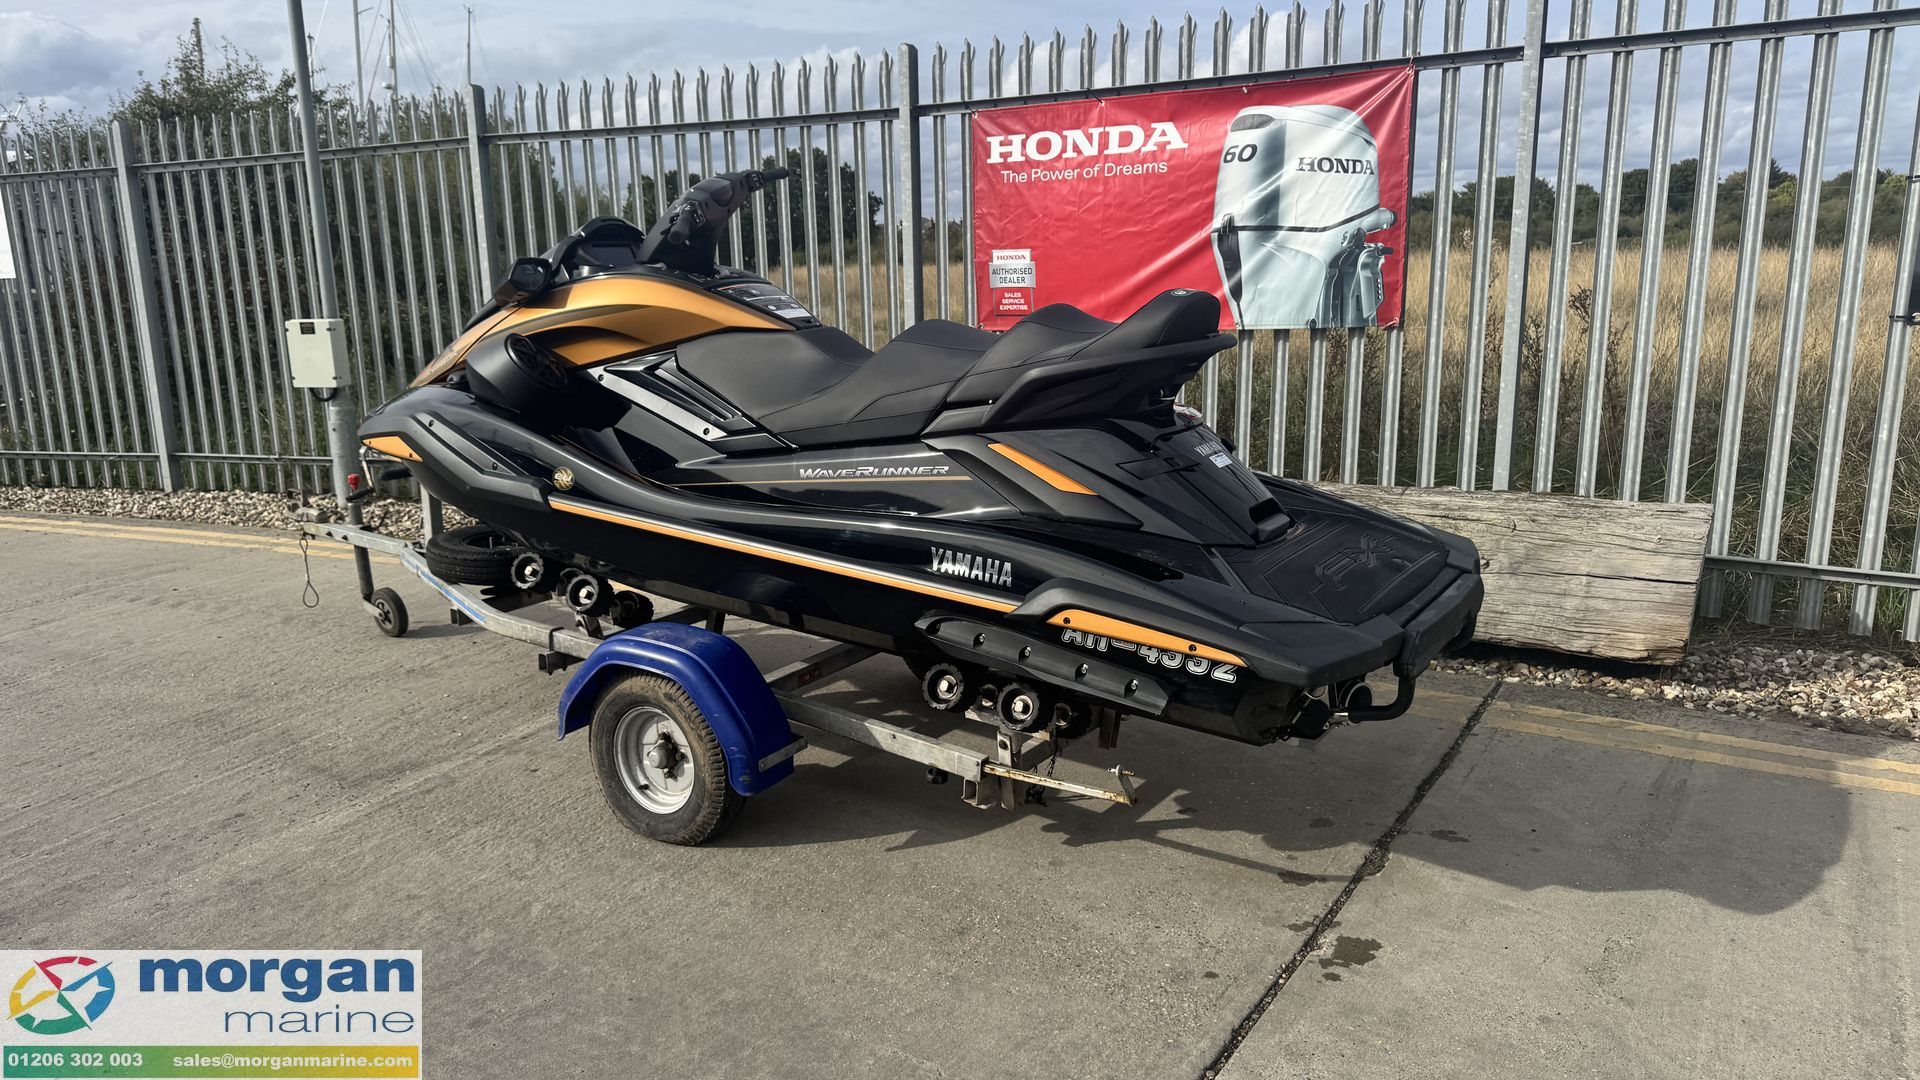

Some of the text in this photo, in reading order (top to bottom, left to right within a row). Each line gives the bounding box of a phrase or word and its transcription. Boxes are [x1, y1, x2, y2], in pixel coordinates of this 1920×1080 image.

[987, 121, 1189, 164] HONDA
[1223, 143, 1258, 164] 60
[1001, 161, 1168, 184] The Power of Dreams
[1296, 157, 1375, 175] HONDA
[991, 267, 1033, 275] AUTHORISED
[999, 276, 1026, 284] DEALER
[931, 546, 1012, 587] YAMAHA
